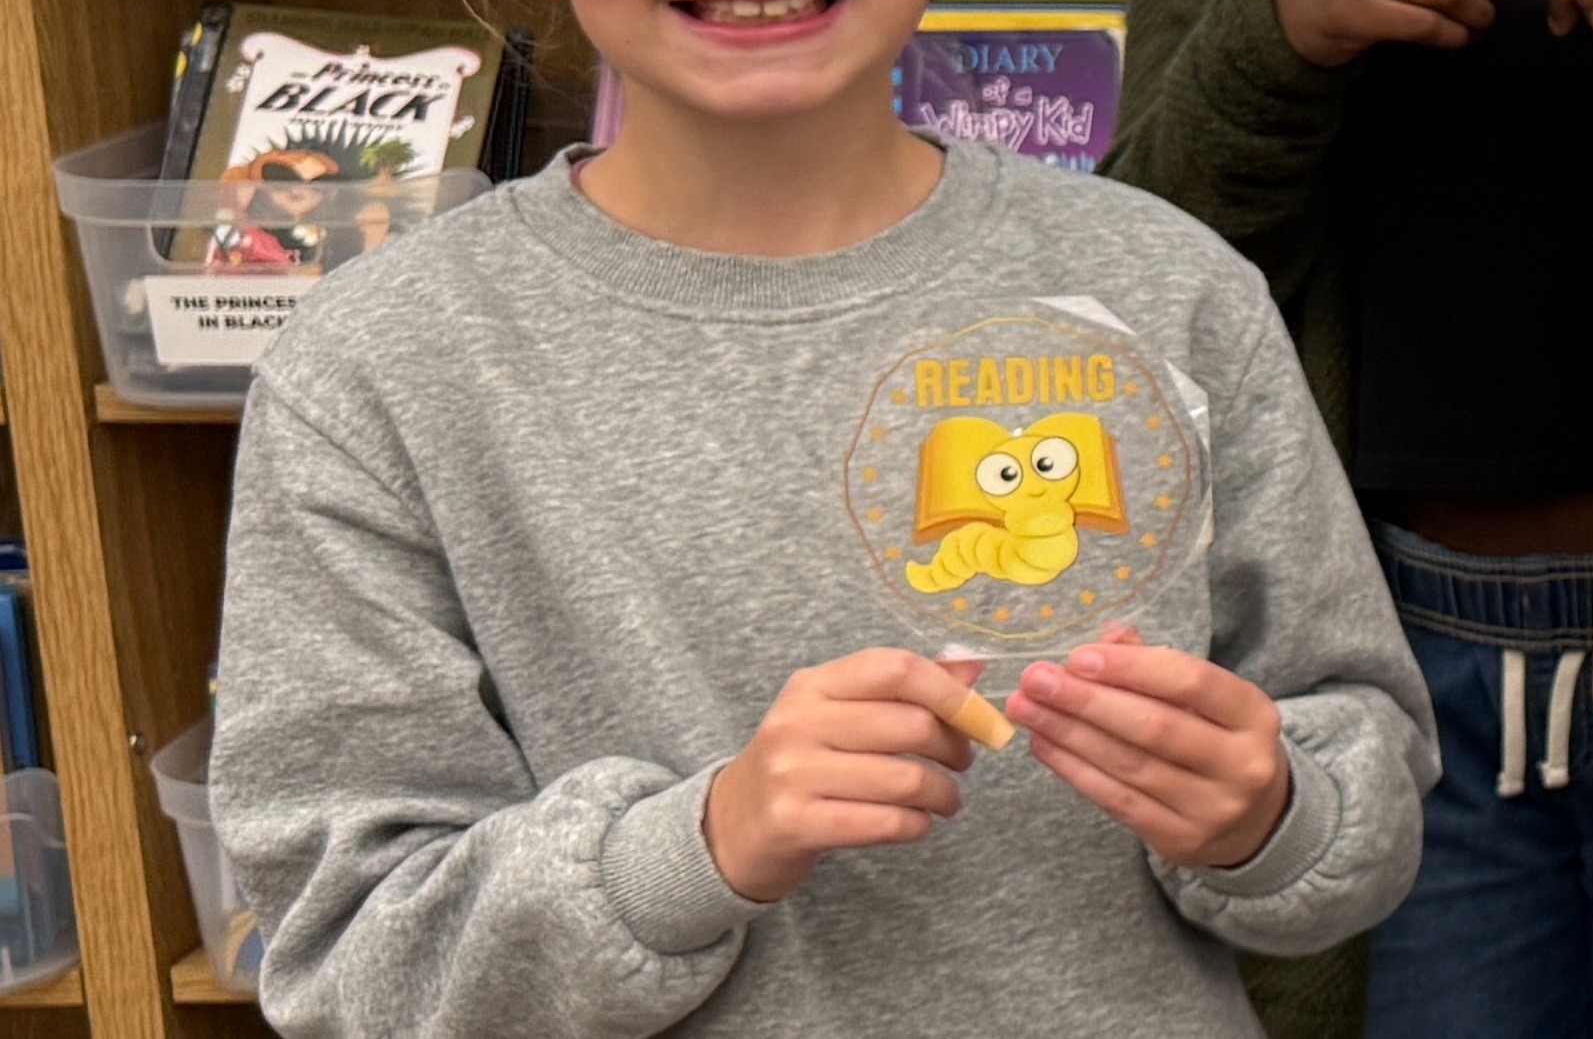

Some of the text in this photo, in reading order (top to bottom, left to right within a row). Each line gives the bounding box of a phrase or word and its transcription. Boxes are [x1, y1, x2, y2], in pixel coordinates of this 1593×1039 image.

[952, 42, 1065, 73] DIARY
[256, 83, 445, 121] BLACK
[981, 75, 1033, 106] of a
[920, 95, 1094, 153] Wimpy Kid
[171, 295, 297, 309] THE PRINCES
[199, 315, 219, 329] IN
[914, 354, 1115, 408] READING
